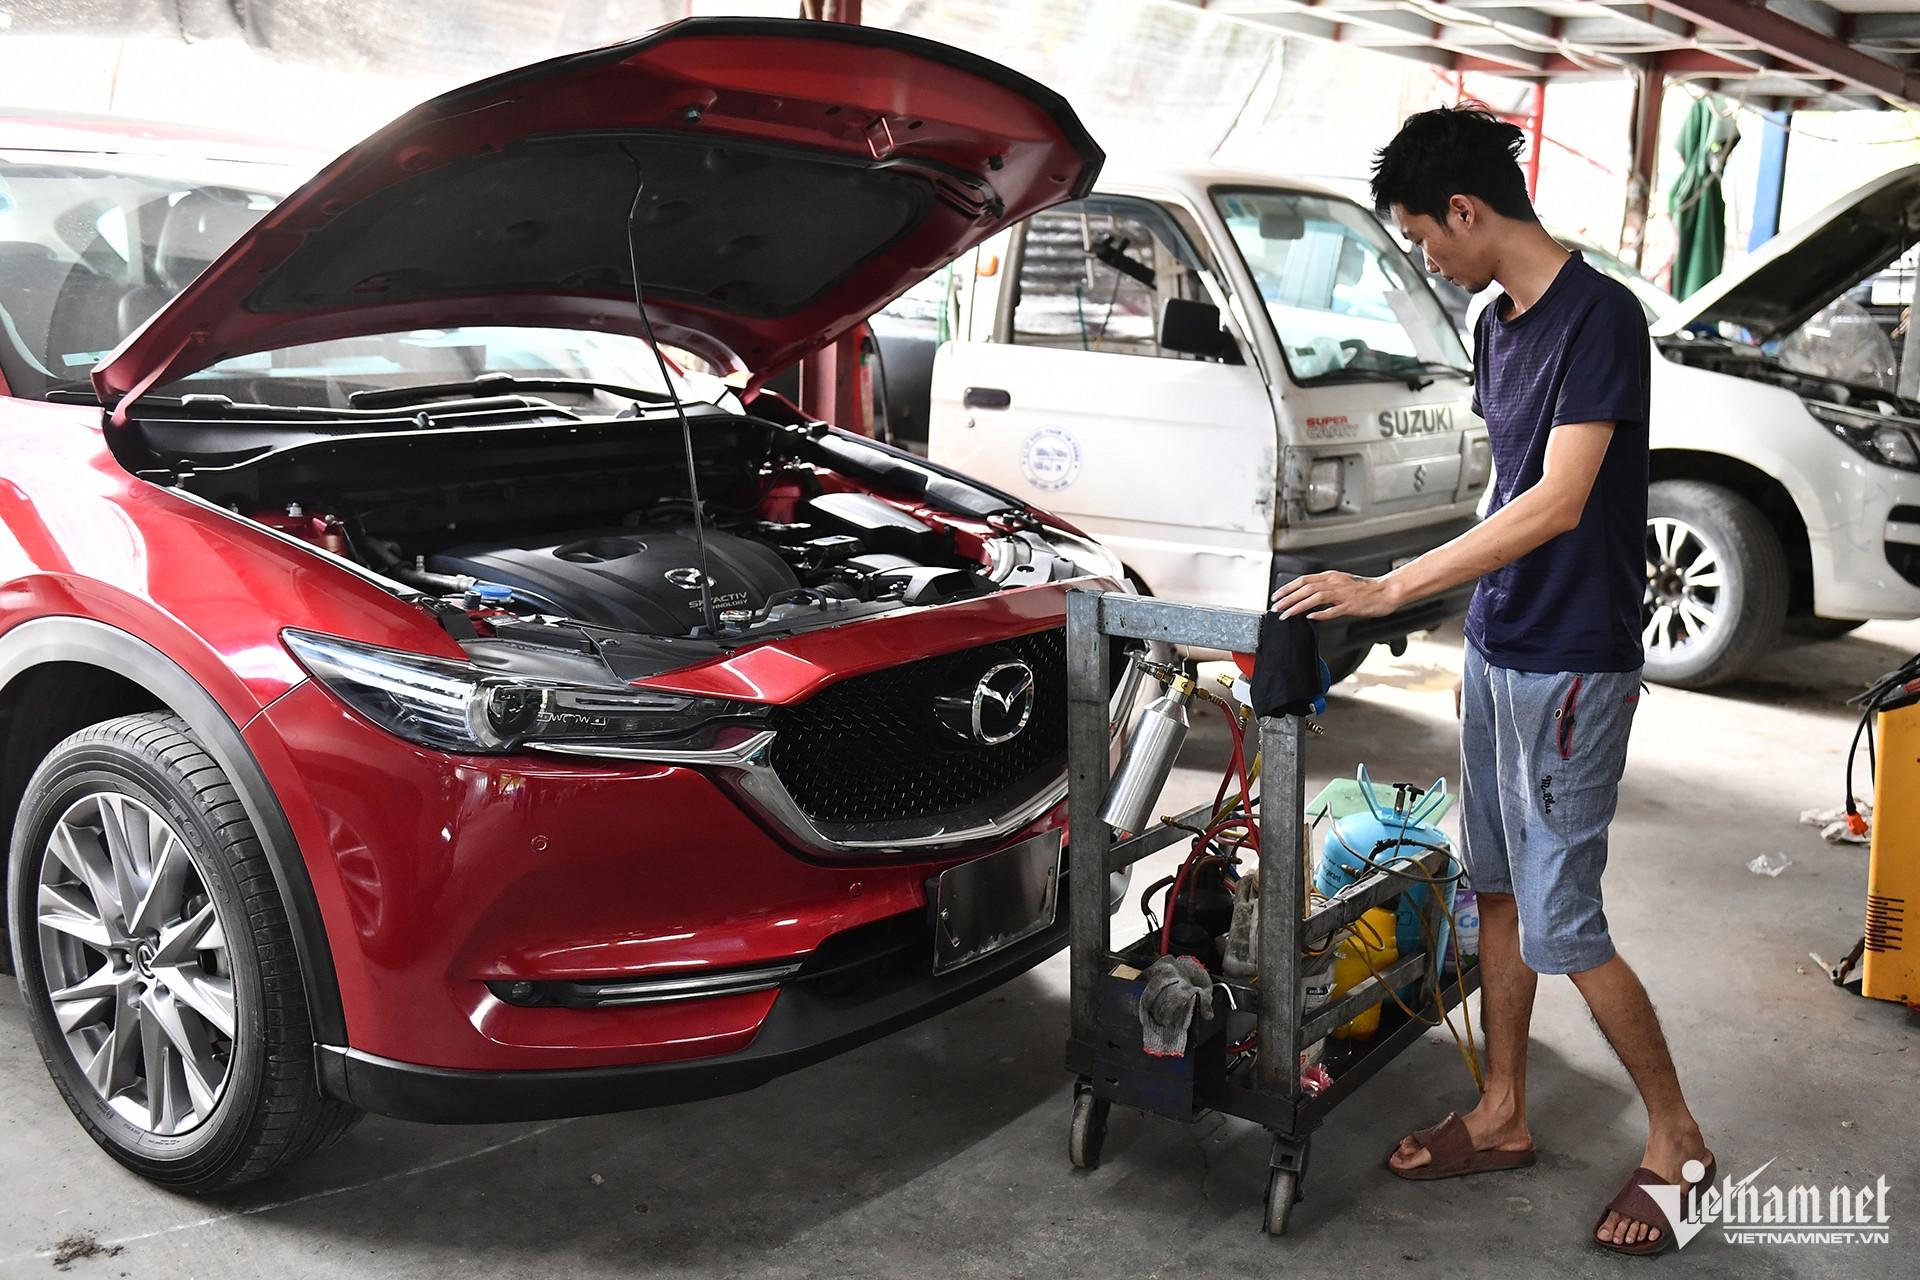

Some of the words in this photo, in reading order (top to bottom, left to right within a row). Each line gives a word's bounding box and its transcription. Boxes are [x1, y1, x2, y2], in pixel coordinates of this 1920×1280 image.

[1306, 415, 1349, 427] SUPER
[1378, 407, 1454, 438] SUZUKI
[688, 591, 747, 609] SKACTIV
[697, 599, 748, 613] THNOLOGY
